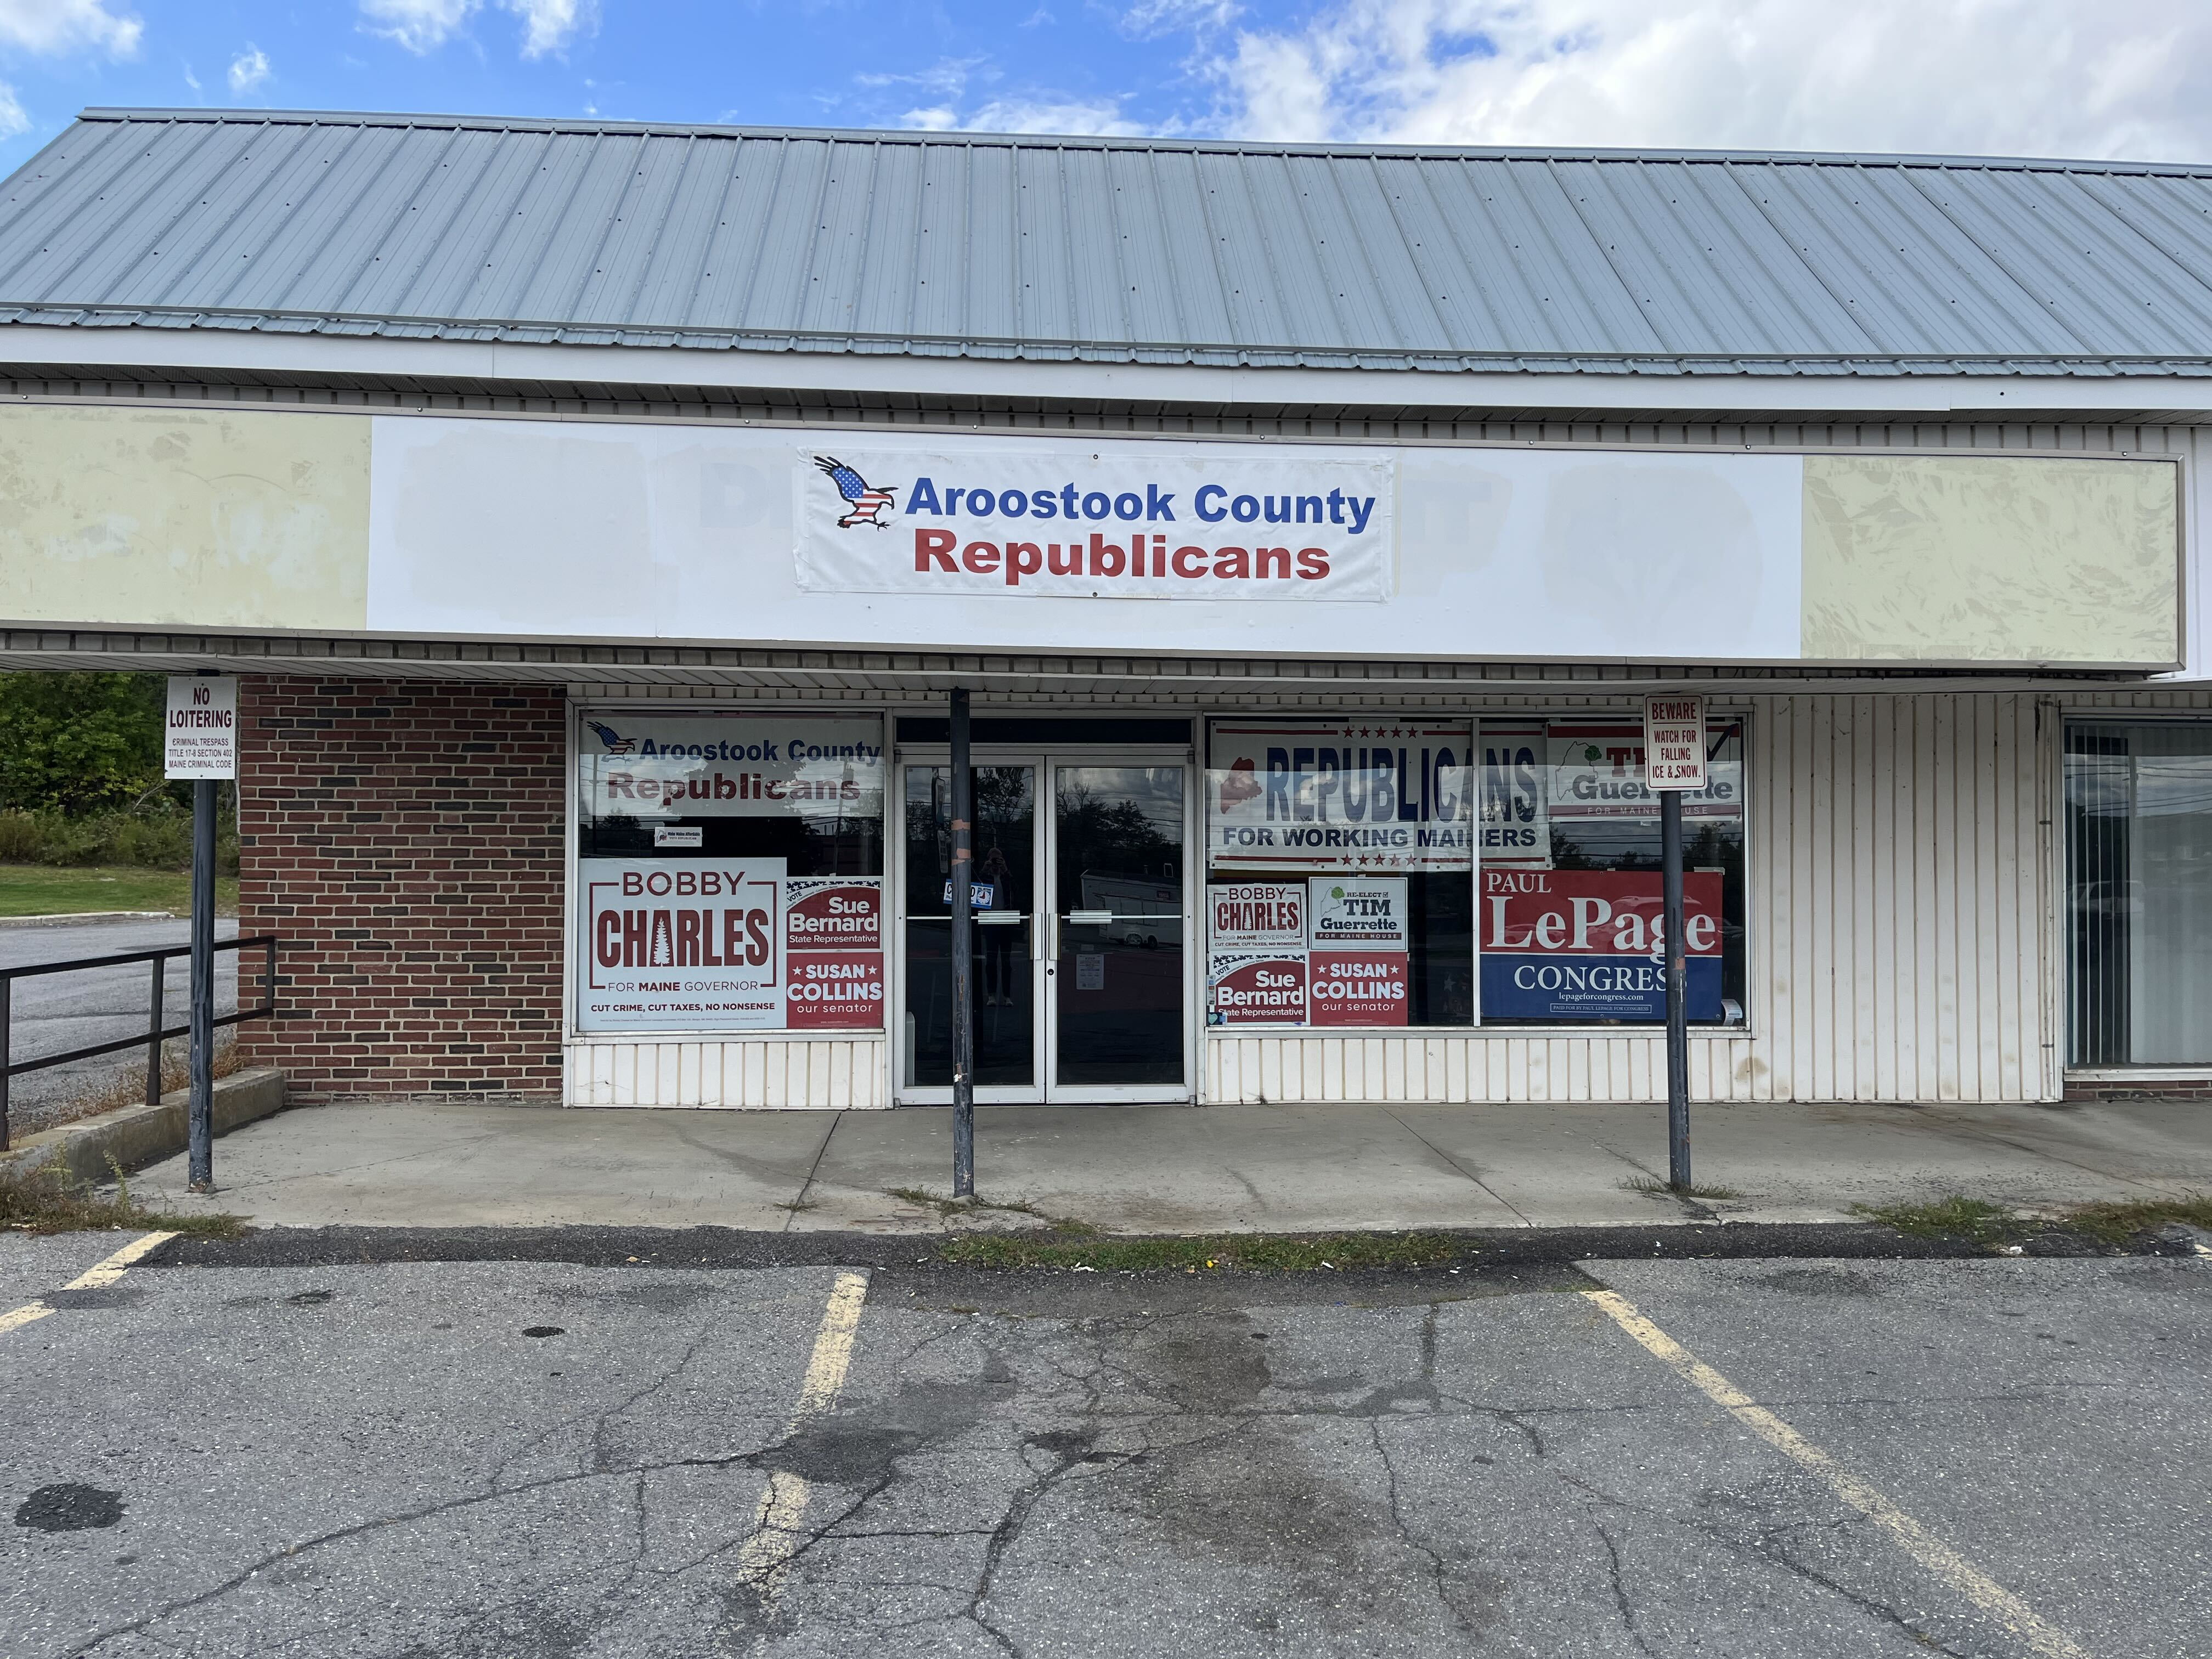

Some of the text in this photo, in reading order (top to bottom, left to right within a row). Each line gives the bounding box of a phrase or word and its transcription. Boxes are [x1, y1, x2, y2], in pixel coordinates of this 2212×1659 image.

[905, 477, 1176, 522] Aroostook
[1194, 483, 1375, 534] County
[914, 529, 1331, 585] Republicans
[193, 687, 210, 705] NO
[170, 710, 232, 728] LOITERING
[1652, 702, 1697, 720] BEWARE
[200, 738, 229, 746] TRESPASS
[1654, 730, 1696, 743] WATCH FOR
[639, 738, 881, 765] Aroostook County
[1661, 748, 1691, 760] FALLING
[169, 760, 232, 768] MAINE CRIMINAL CODE
[1606, 747, 1645, 777] TI
[1652, 765, 1664, 778] ICE
[1668, 765, 1673, 778] &
[608, 772, 861, 806] Republicans
[1266, 747, 1538, 823] REPUBLICANS
[1572, 775, 1733, 800] Guerte
[1222, 827, 1274, 846] FOR
[1283, 828, 1408, 847] WORKING
[623, 871, 745, 896] BOBBY
[1487, 873, 1552, 893] PAUL
[787, 891, 802, 902] VOTE
[1229, 887, 1286, 900] BOBBY
[828, 896, 870, 914] Sue
[1344, 899, 1391, 916] TIM
[789, 913, 878, 932] Bernard
[1217, 902, 1298, 930] CHARLES
[1321, 918, 1397, 930] Guerrette
[597, 909, 769, 968] CHARLES
[814, 935, 878, 944] Representative
[805, 964, 865, 979] SUSAN
[1216, 965, 1230, 975] VOTE
[1256, 970, 1295, 988] Sue
[1330, 963, 1387, 978] SUSAN
[1514, 966, 1687, 991] CONGRES
[608, 981, 758, 992] FOR MAINE GOVERNOR
[787, 982, 883, 1001] COLLINS
[1312, 981, 1404, 1000] COLLINS
[1218, 986, 1304, 1006] Bernard
[1559, 992, 1644, 1002] lepageforcongress.com
[613, 1004, 645, 1013] CRIME,
[670, 1003, 703, 1012] TAXES,
[797, 1004, 873, 1013] our senator
[1242, 1008, 1304, 1018] Representative
[1347, 1002, 1395, 1011] senator
